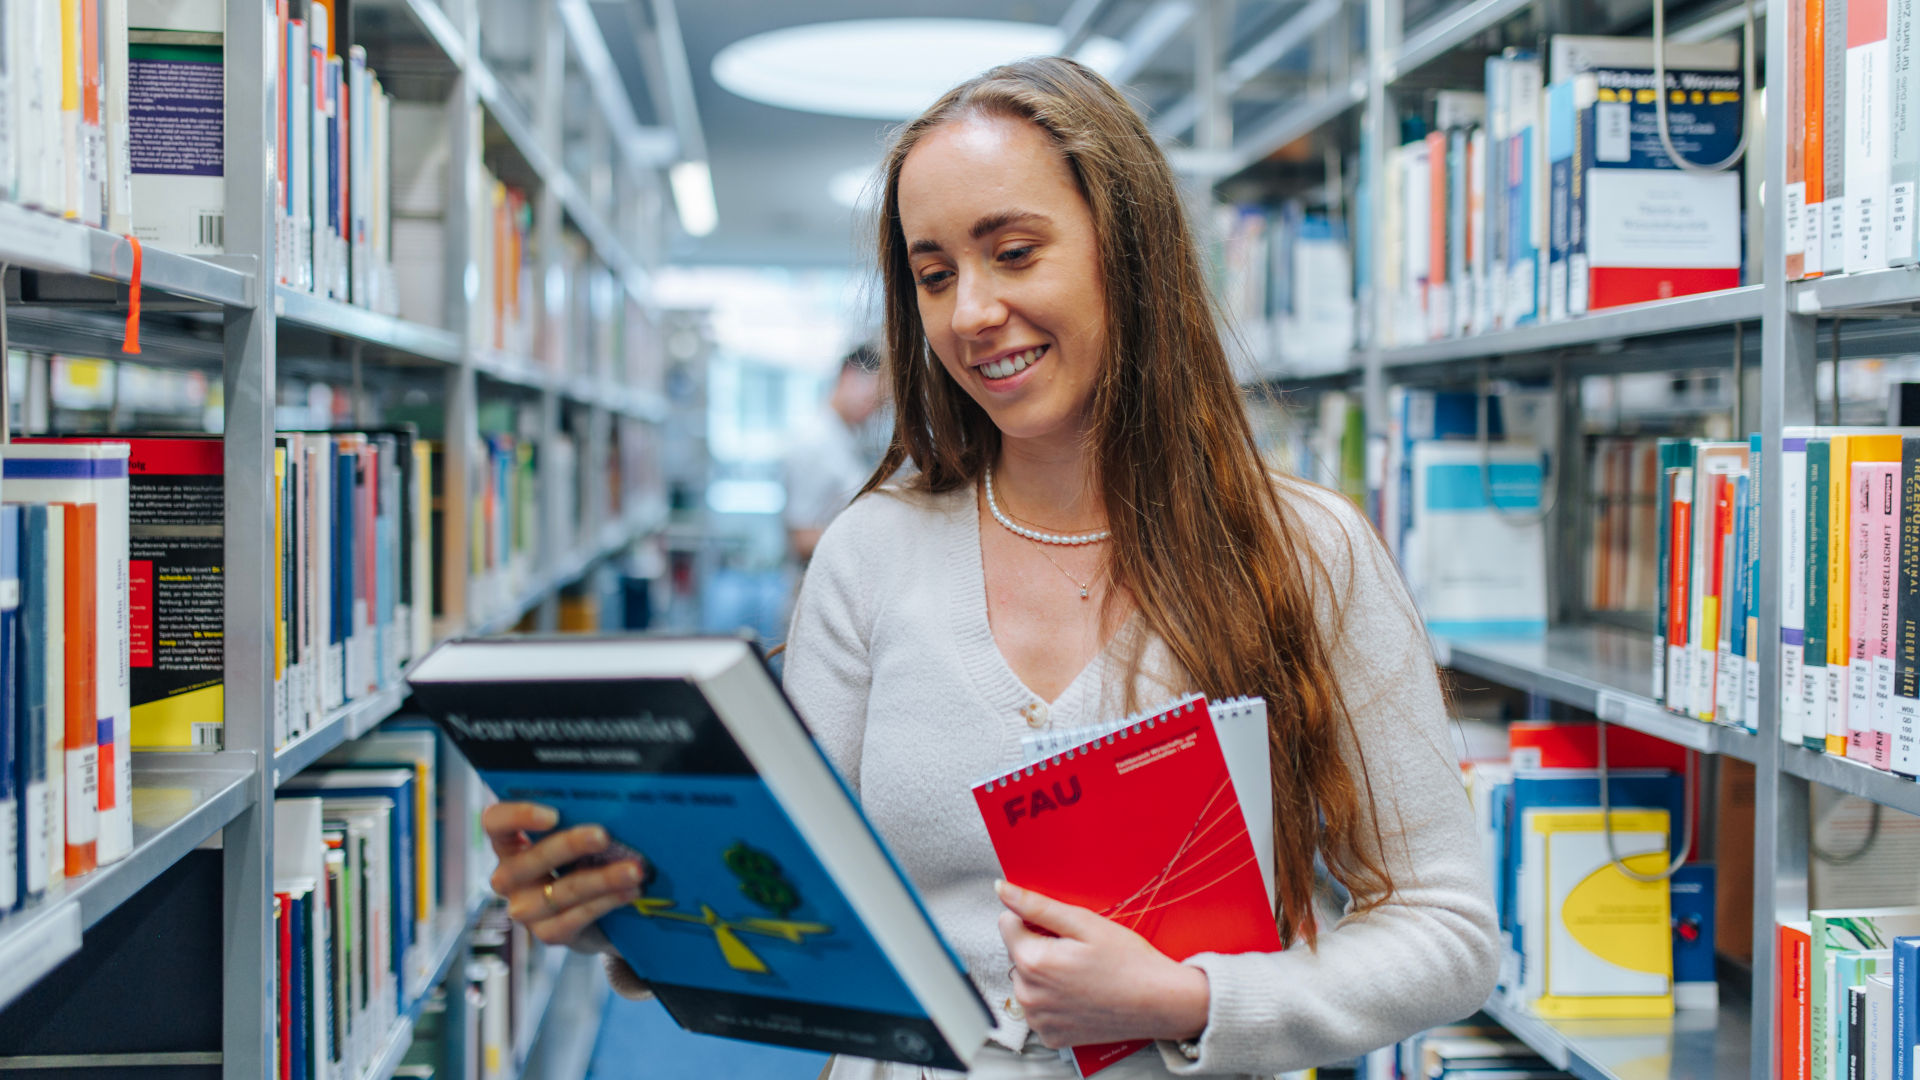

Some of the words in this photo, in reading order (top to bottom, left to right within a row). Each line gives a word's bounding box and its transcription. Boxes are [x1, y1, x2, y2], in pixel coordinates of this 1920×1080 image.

[1902, 21, 1910, 52] harte
[1902, 55, 1910, 72] für
[1900, 76, 1908, 101] Duflo
[1906, 477, 1914, 510] COST
[1809, 485, 1818, 542] Ordnungspolitik
[1903, 516, 1912, 576] SOCIETY
[1910, 525, 1918, 596] MARGINAL
[1905, 620, 1915, 662] JEREMY
[1903, 666, 1914, 698] RIFKI
[446, 710, 694, 744] Neuroeconomics
[1115, 750, 1150, 769] Fachbereich
[1150, 738, 1184, 756] Wirtschafts-
[1184, 732, 1197, 743] und
[1181, 740, 1196, 750] WiSo
[1002, 774, 1082, 828] FAU
[1870, 1001, 1879, 1039] Zukunft
